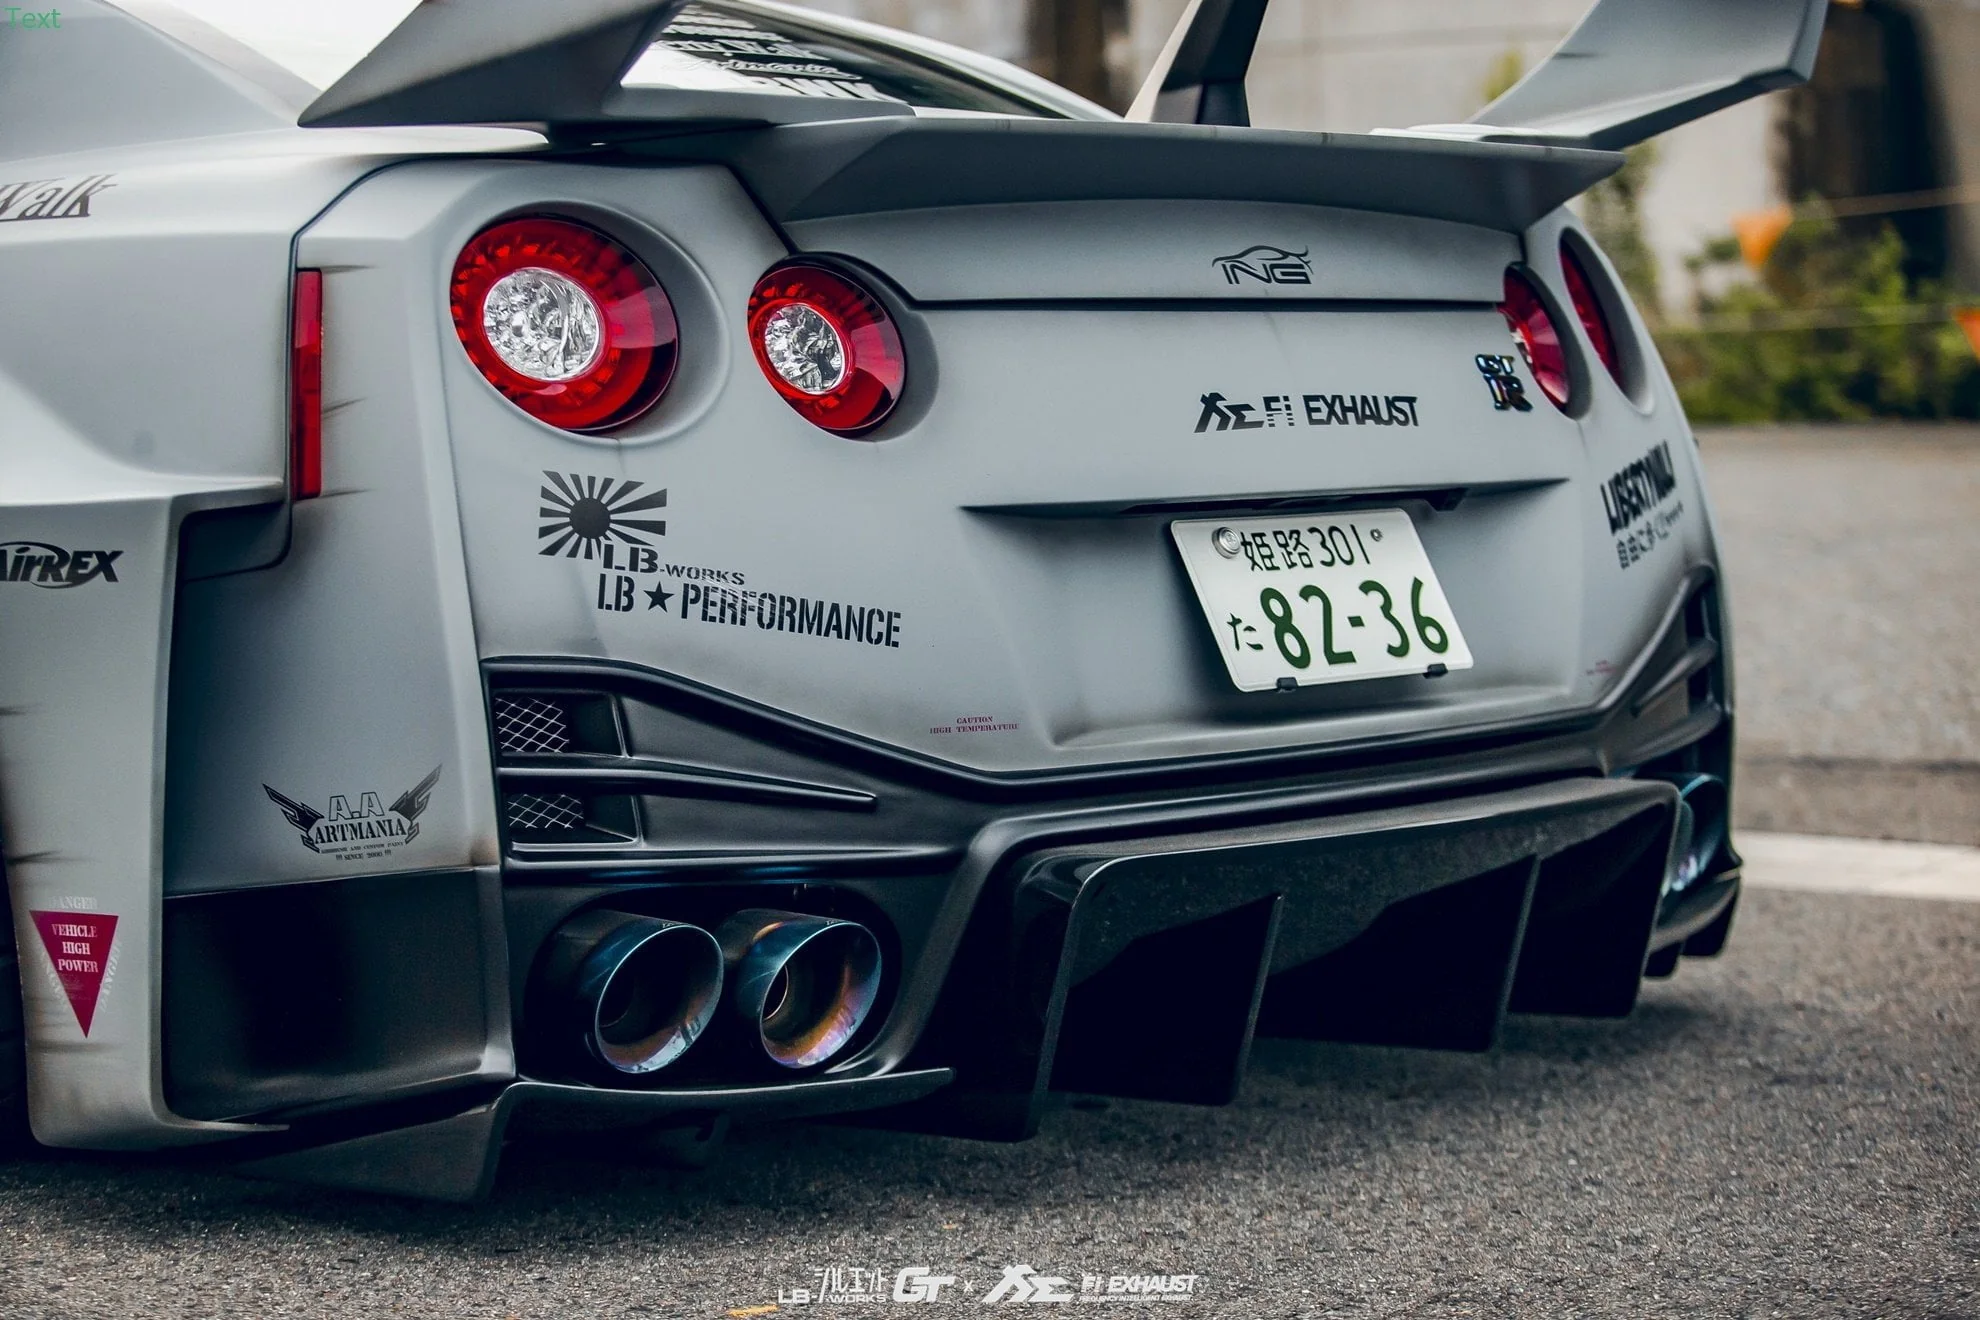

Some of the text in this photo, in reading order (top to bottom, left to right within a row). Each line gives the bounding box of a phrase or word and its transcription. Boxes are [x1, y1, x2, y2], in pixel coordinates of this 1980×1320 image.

[1221, 262, 1312, 285] ING
[1302, 394, 1419, 427] EXHAUST
[597, 573, 902, 648] LB PERFORMANCE
[1226, 612, 1264, 652] た
[1259, 576, 1449, 670] 82-36
[929, 726, 952, 735] HIGH
[956, 716, 993, 725] CAUTION
[314, 818, 407, 845] ARTMANIA
[51, 924, 98, 938] VEHICLE
[62, 941, 92, 955] HIGH
[57, 958, 99, 973] POWER
